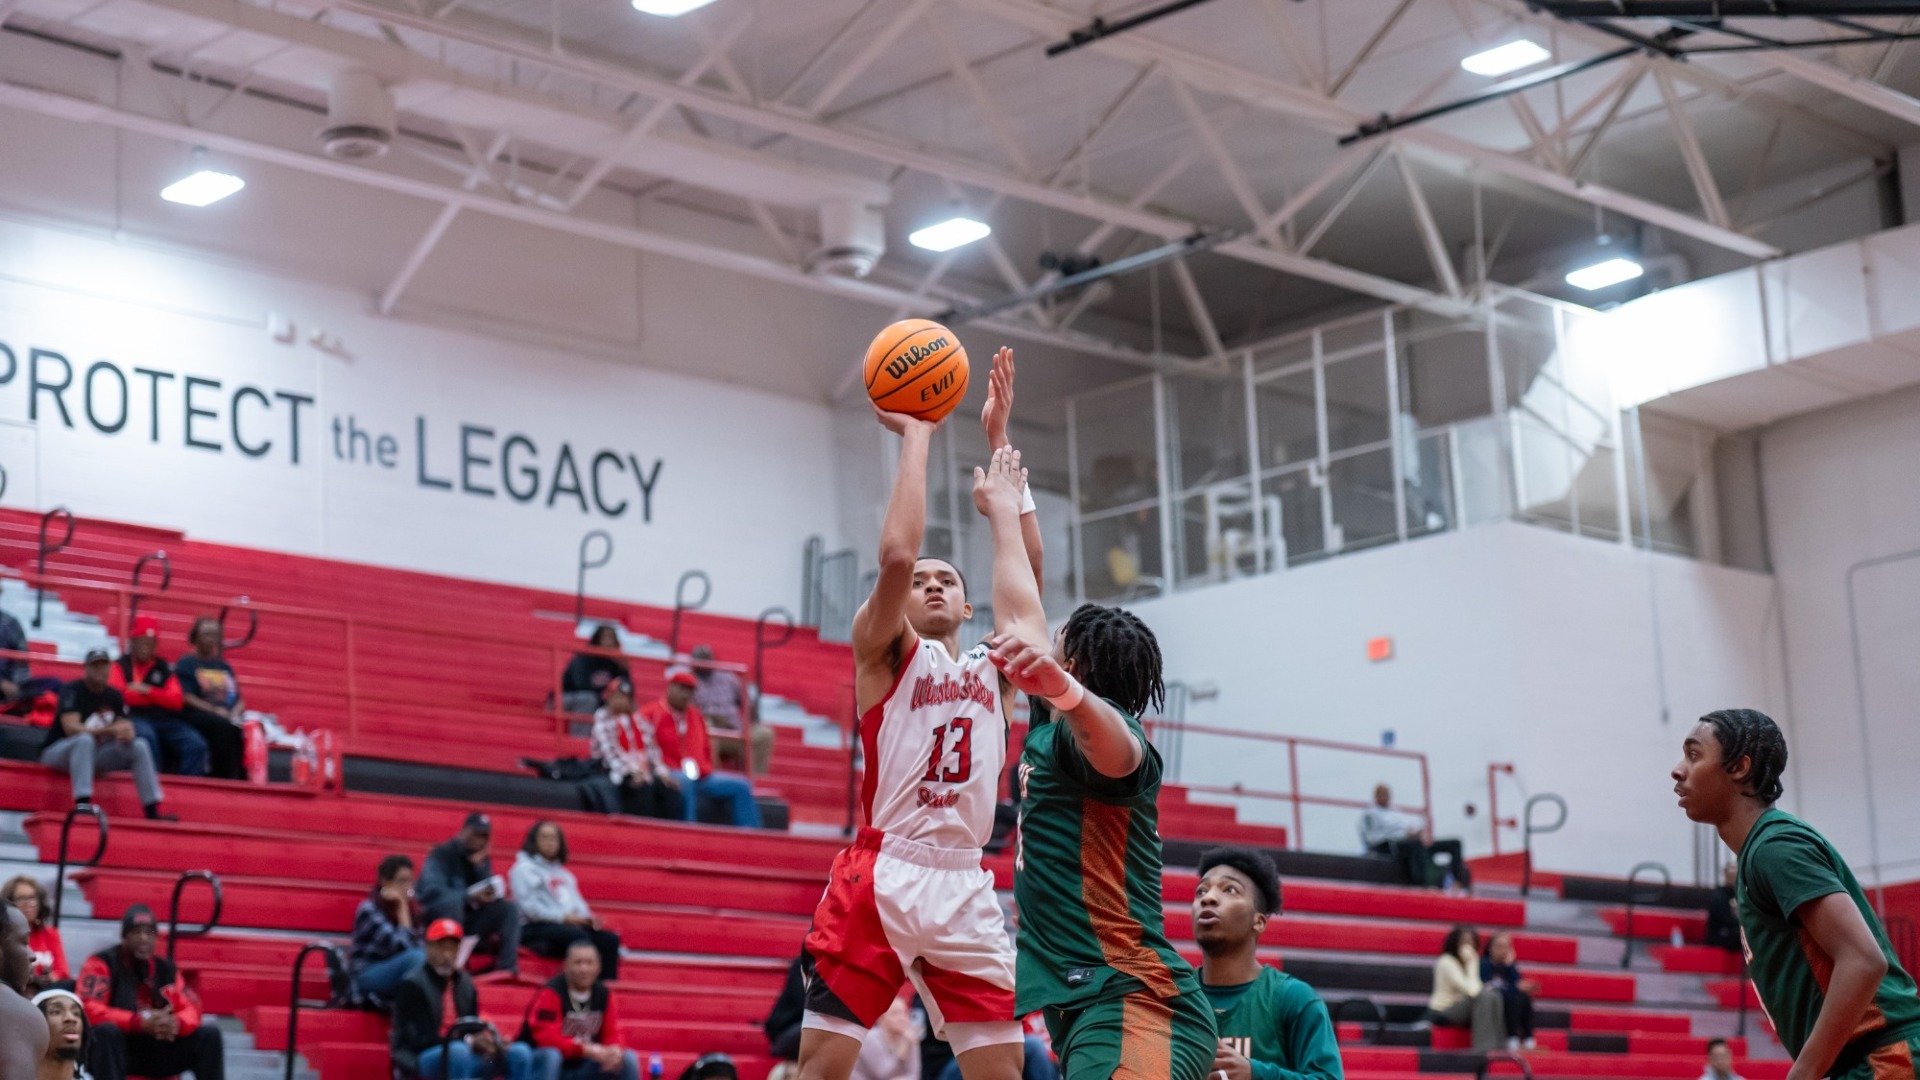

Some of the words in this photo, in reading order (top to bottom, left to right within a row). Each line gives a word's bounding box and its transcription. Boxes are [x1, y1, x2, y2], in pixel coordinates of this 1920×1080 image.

[885, 337, 949, 379] Wilson
[332, 414, 398, 468] the
[416, 415, 663, 524] LEGACY
[921, 717, 972, 783] 13
